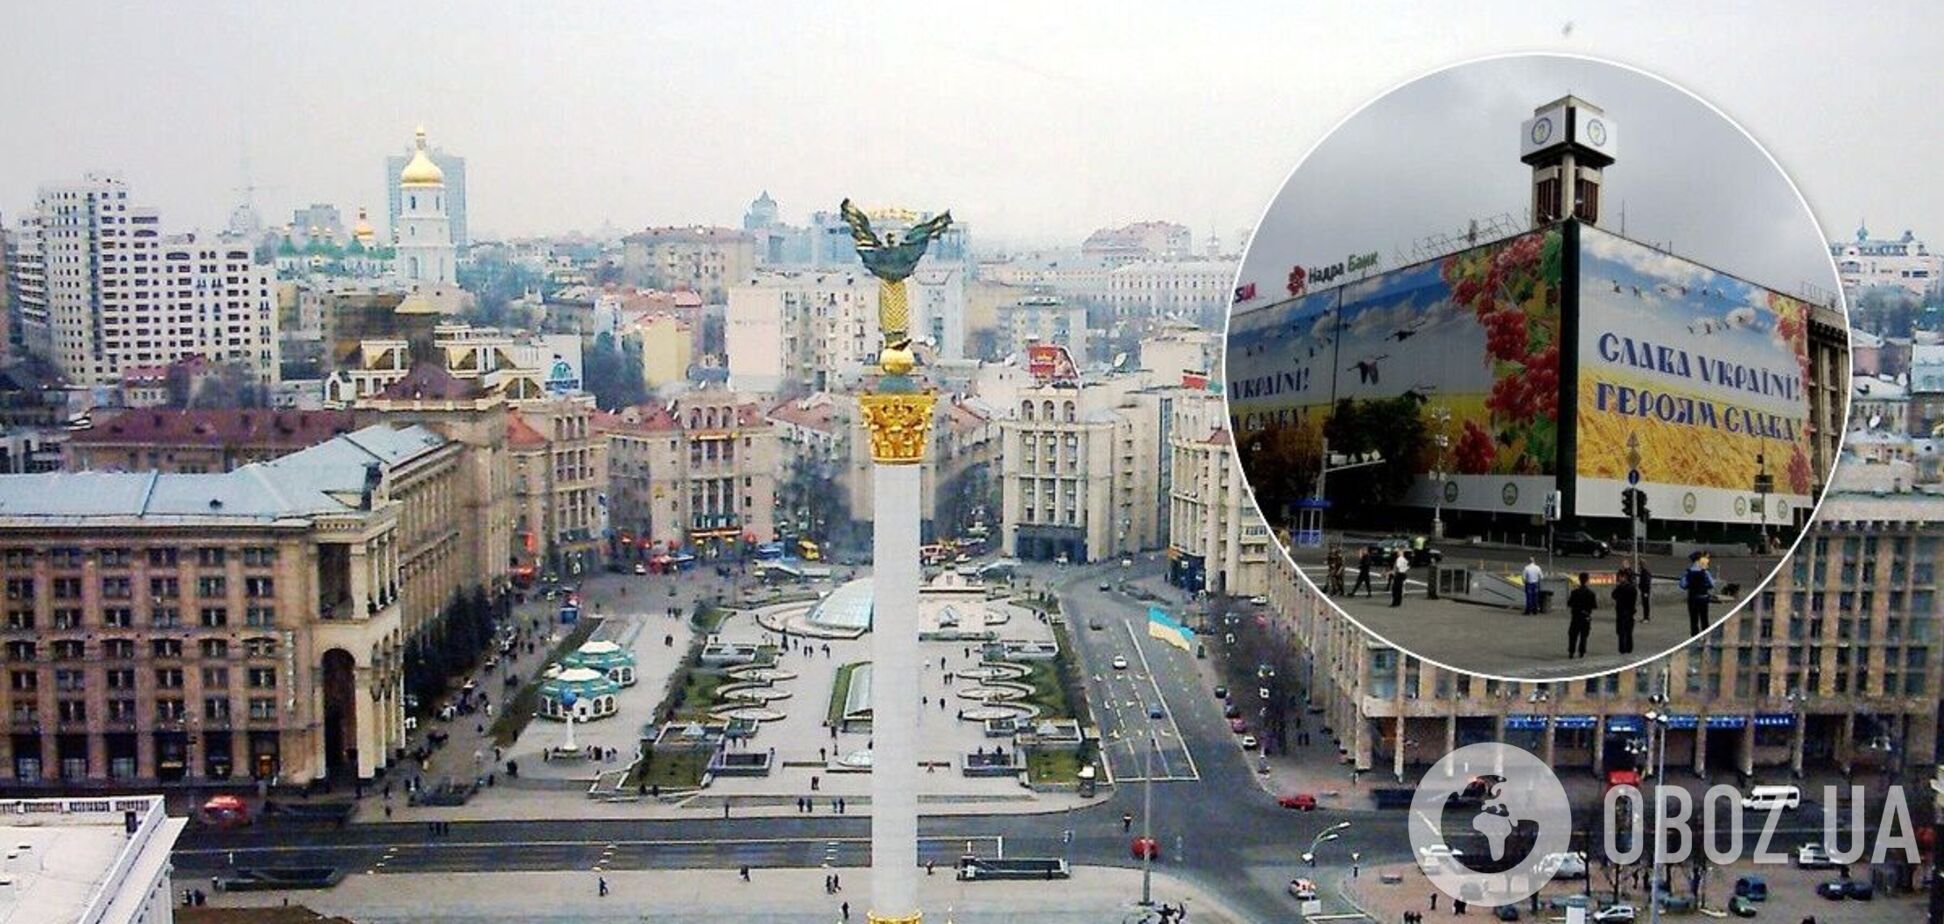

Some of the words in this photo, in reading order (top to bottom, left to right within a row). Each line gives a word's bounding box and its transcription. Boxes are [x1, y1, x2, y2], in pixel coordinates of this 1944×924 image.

[1308, 262, 1345, 284] Надра
[1348, 251, 1378, 272] Банк
[1598, 332, 1691, 378] СЛАВА
[1596, 382, 1718, 429] ГЕРОЯМ
